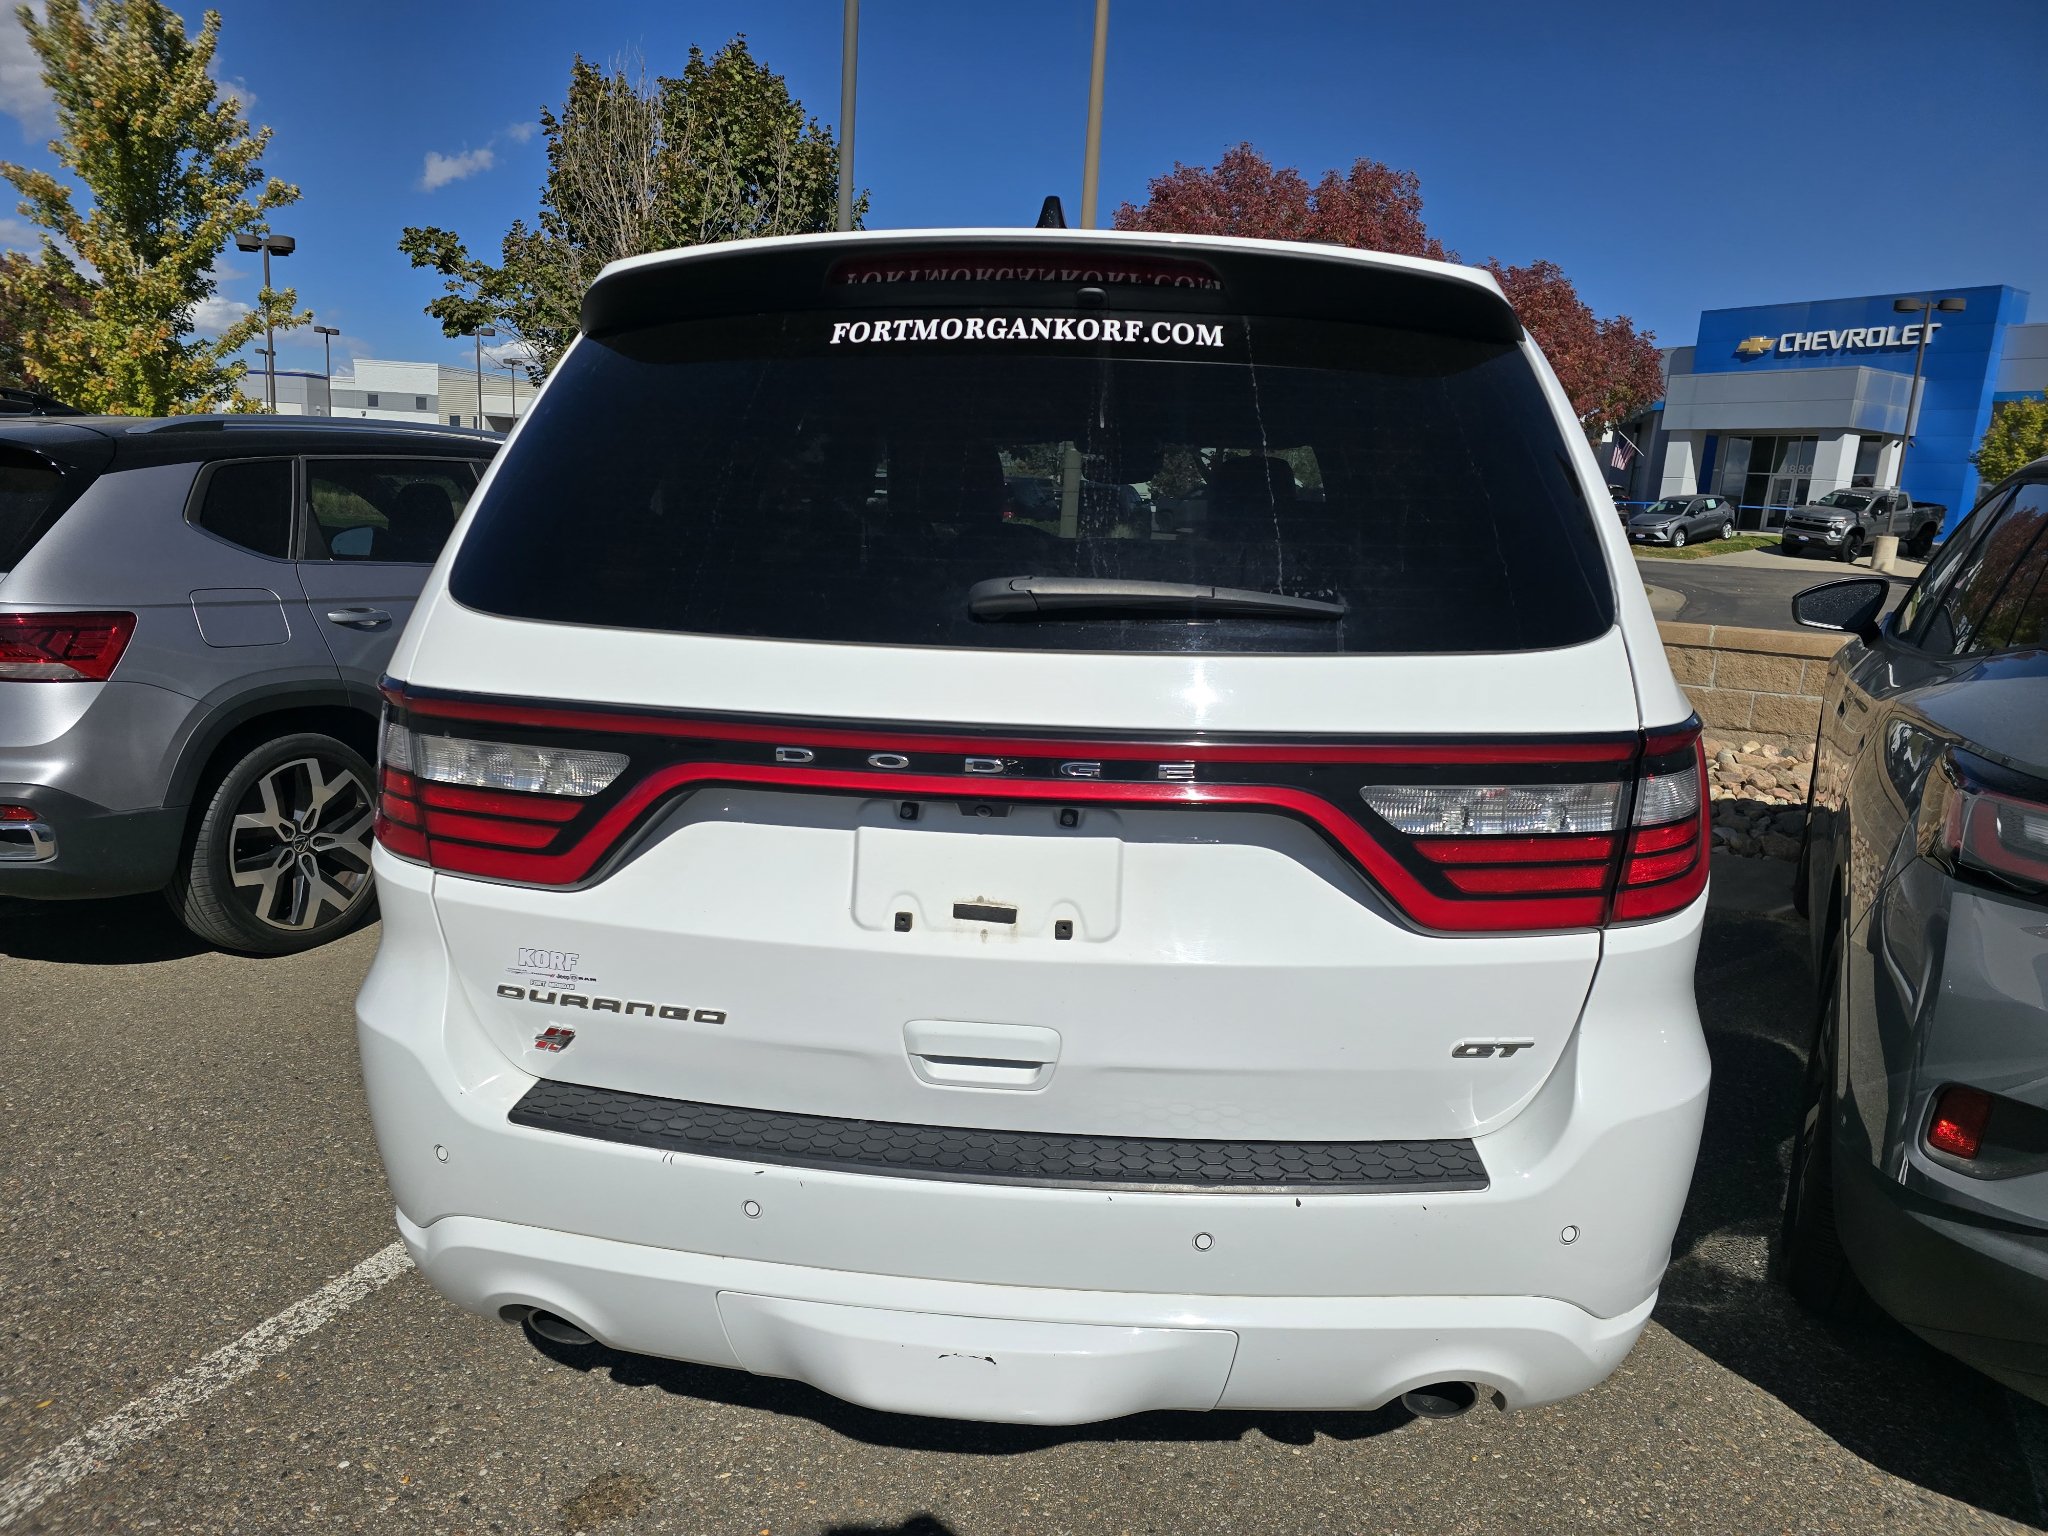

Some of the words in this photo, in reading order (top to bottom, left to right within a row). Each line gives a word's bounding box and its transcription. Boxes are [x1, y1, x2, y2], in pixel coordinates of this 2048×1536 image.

[829, 317, 1225, 347] FORTMORGANKORF.COM
[1779, 322, 1943, 353] CHEVROLET
[775, 746, 1197, 781] DODGE
[518, 947, 580, 972] KORF
[496, 983, 729, 1026] DURANGO
[1451, 1040, 1535, 1059] GT
